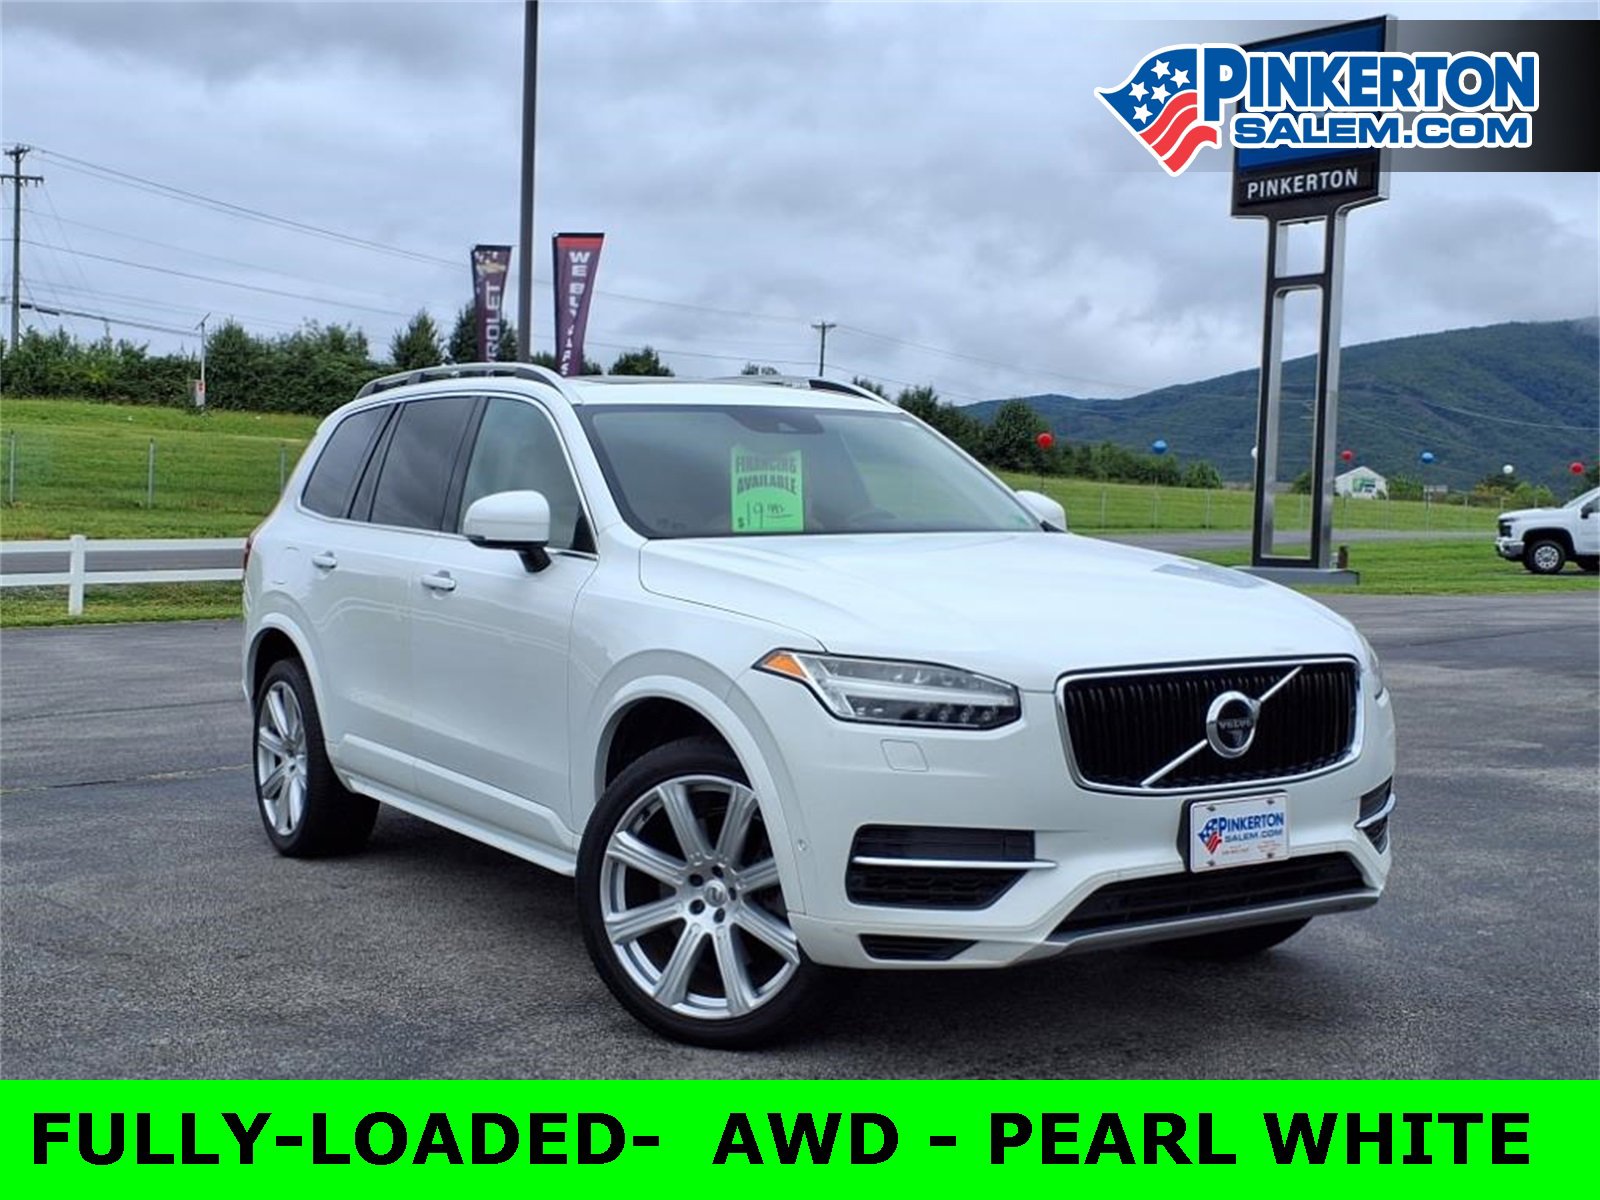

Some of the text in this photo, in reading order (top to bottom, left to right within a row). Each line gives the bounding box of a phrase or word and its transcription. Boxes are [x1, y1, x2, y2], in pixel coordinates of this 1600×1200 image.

[1246, 167, 1359, 199] PINKERTON
[737, 473, 797, 496] AVAILABLE
[1218, 812, 1285, 838] PINKERTON
[1224, 829, 1284, 843] SALEM.COM
